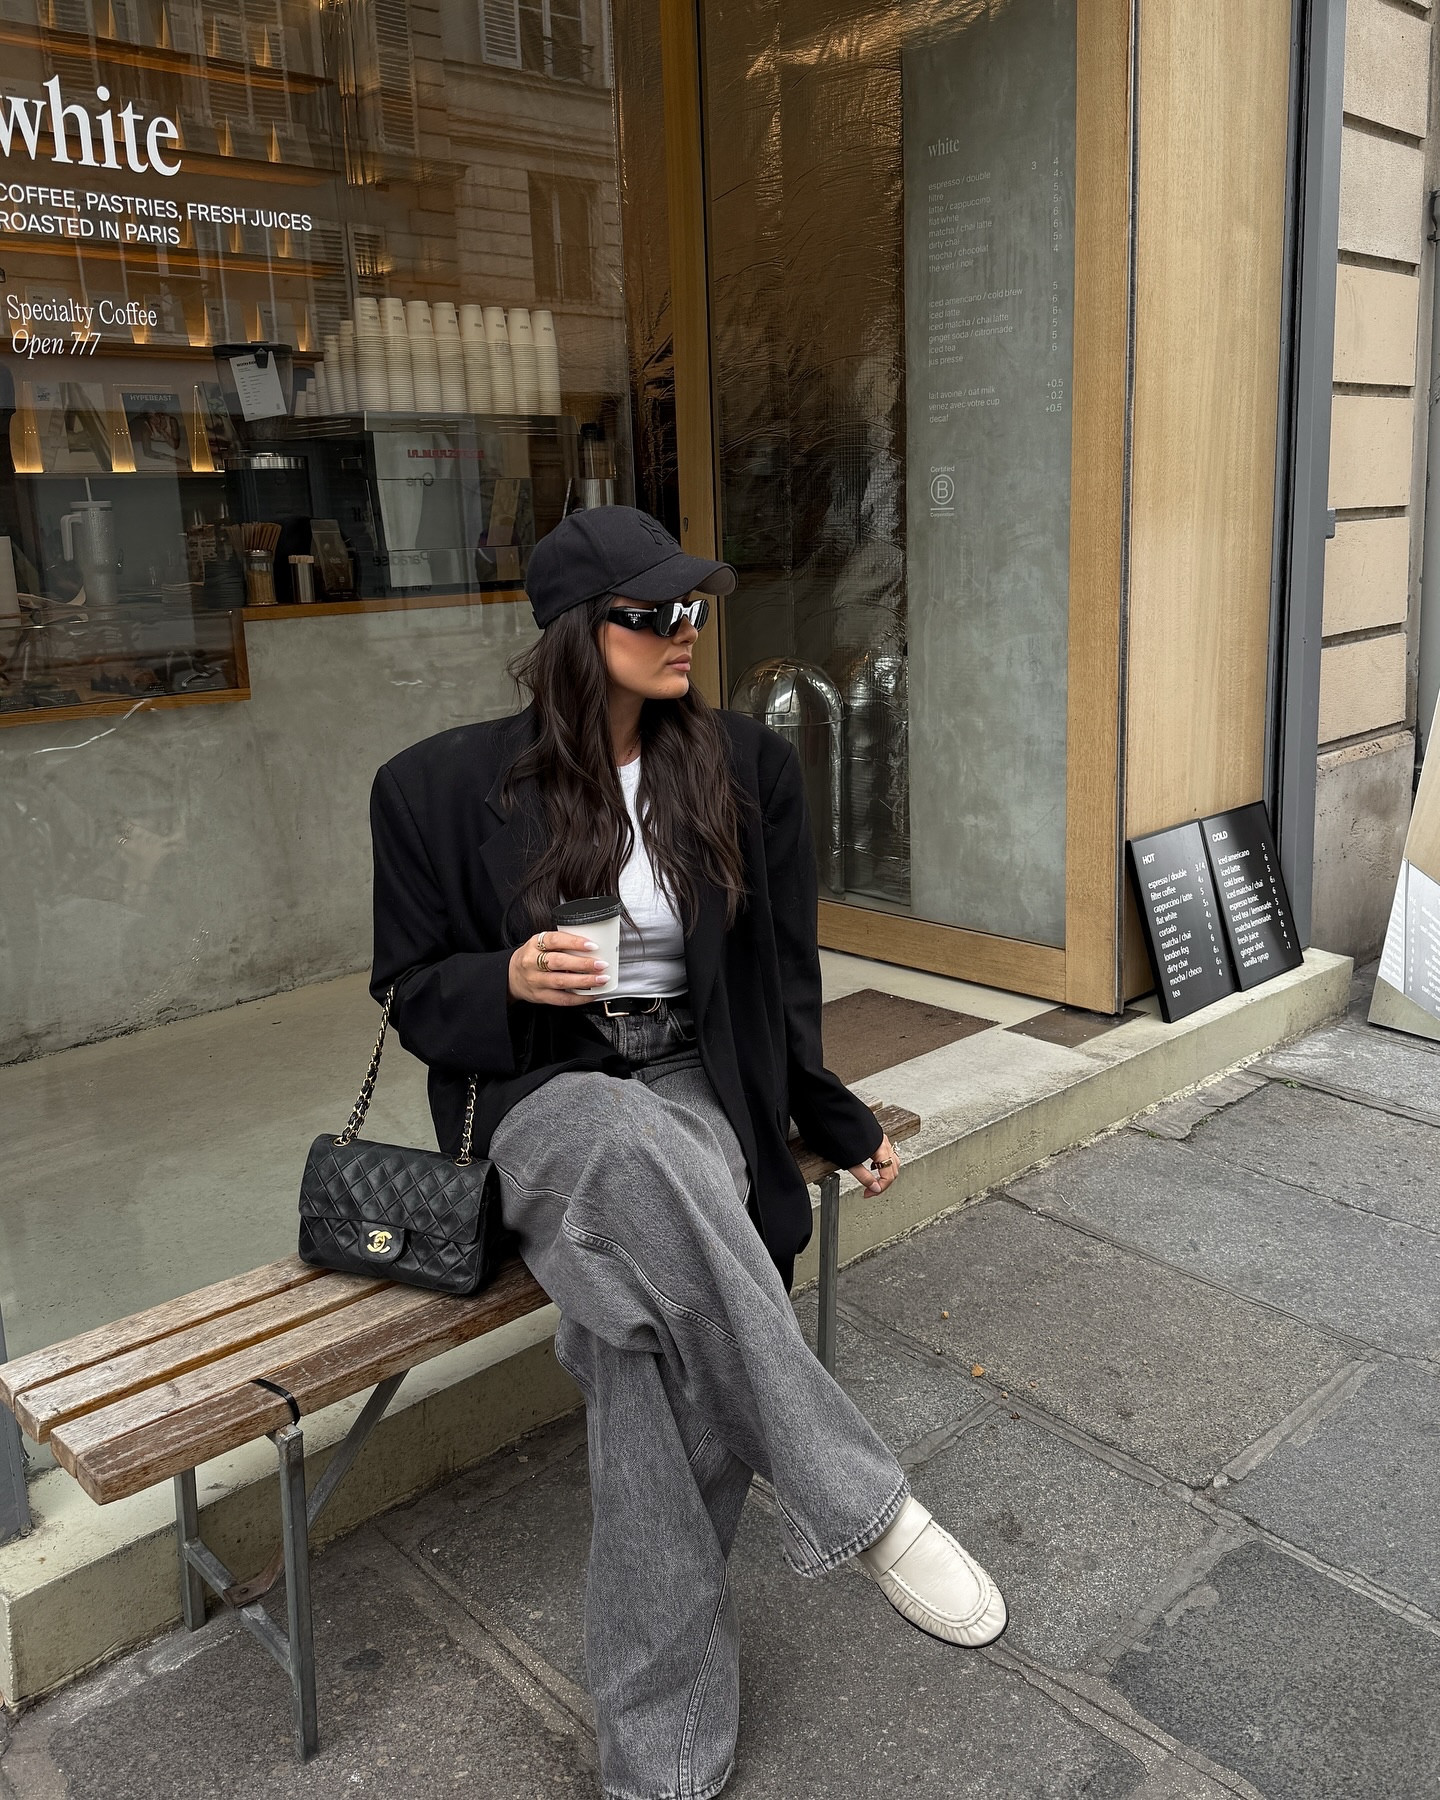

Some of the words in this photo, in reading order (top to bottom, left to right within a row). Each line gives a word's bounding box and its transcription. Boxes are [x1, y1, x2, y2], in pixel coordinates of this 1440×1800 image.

[0, 74, 182, 177] white
[928, 138, 960, 157] white
[928, 178, 960, 191] espresso
[966, 171, 991, 182] double
[1032, 161, 1036, 170] 3
[86, 192, 182, 222] PASTRIES,
[188, 204, 245, 225] FRESH
[251, 210, 312, 231] JUICES
[928, 204, 944, 214] latte
[950, 196, 991, 211] cappuccino
[941, 214, 959, 223] white
[0, 212, 93, 237] ROASTED
[100, 220, 119, 240] IN
[126, 223, 180, 244] PARIS
[929, 228, 954, 238] matcha
[977, 219, 992, 229] latte
[929, 240, 944, 250] dirty
[929, 252, 952, 261] mocha
[958, 244, 989, 256] chocolat
[929, 298, 944, 308] iced
[945, 295, 982, 306] americano
[988, 290, 1003, 298] cold
[1005, 288, 1023, 296] brew
[7, 295, 94, 328] Specialty
[99, 300, 157, 327] Coffee
[929, 311, 944, 319] iced
[929, 322, 943, 331] iced
[945, 319, 970, 329] matcha
[977, 315, 991, 324] chai
[993, 314, 1008, 322] latte
[928, 334, 950, 345] ginger
[952, 331, 969, 340] soda
[975, 325, 1013, 337] citronnade
[12, 329, 64, 359] Open
[70, 332, 101, 356] 7/7
[929, 346, 943, 354] iced
[928, 356, 939, 367] jus
[981, 385, 995, 394] milk
[1046, 378, 1064, 388] +0.5
[929, 402, 948, 411] venez
[950, 400, 966, 410] avec
[967, 399, 985, 407] votre
[986, 398, 1000, 406] cup
[930, 414, 949, 423] decaf
[1045, 403, 1062, 412] +0.5
[937, 480, 948, 499] B
[1212, 831, 1228, 842] COLD
[1142, 853, 1155, 864] HOT
[1217, 856, 1228, 865] iced
[1228, 850, 1250, 862] americano
[1221, 866, 1231, 876] iced
[1231, 864, 1241, 873] latte
[1148, 876, 1168, 889] espresso
[1171, 869, 1187, 881] double
[1224, 878, 1233, 888] cold
[1233, 876, 1245, 884] brew
[1150, 891, 1161, 901] filter
[1162, 886, 1176, 897] coffee
[1226, 890, 1236, 899] iced
[1236, 884, 1251, 895] matcha
[1254, 879, 1264, 889] chai
[1153, 898, 1180, 913] cappuccino
[1182, 893, 1193, 902] latte
[1229, 899, 1248, 911] espresso
[1248, 894, 1259, 903] tonic
[1156, 916, 1165, 925] flat
[1164, 911, 1178, 922] white
[1232, 912, 1241, 922] iced
[1251, 901, 1272, 914] lemonade
[1159, 924, 1177, 937] cortado
[1235, 922, 1251, 933] matcha
[1250, 913, 1272, 927] lemonade
[1161, 936, 1179, 950] matcha
[1182, 930, 1192, 941] chai
[1208, 922, 1212, 930] 6
[1237, 934, 1248, 945] fresh
[1248, 931, 1259, 942] juice
[1163, 949, 1181, 962] london
[1181, 945, 1190, 955] fog
[1210, 934, 1215, 942] 6
[1240, 948, 1254, 958] ginger
[1254, 941, 1265, 950] shot
[1166, 962, 1178, 974] dirty
[1178, 958, 1189, 968] chai
[1243, 956, 1257, 968] vanilla
[1257, 952, 1269, 963] syrup
[1170, 973, 1186, 986] mocha
[1188, 966, 1202, 978] choco
[1172, 989, 1181, 998] tea
